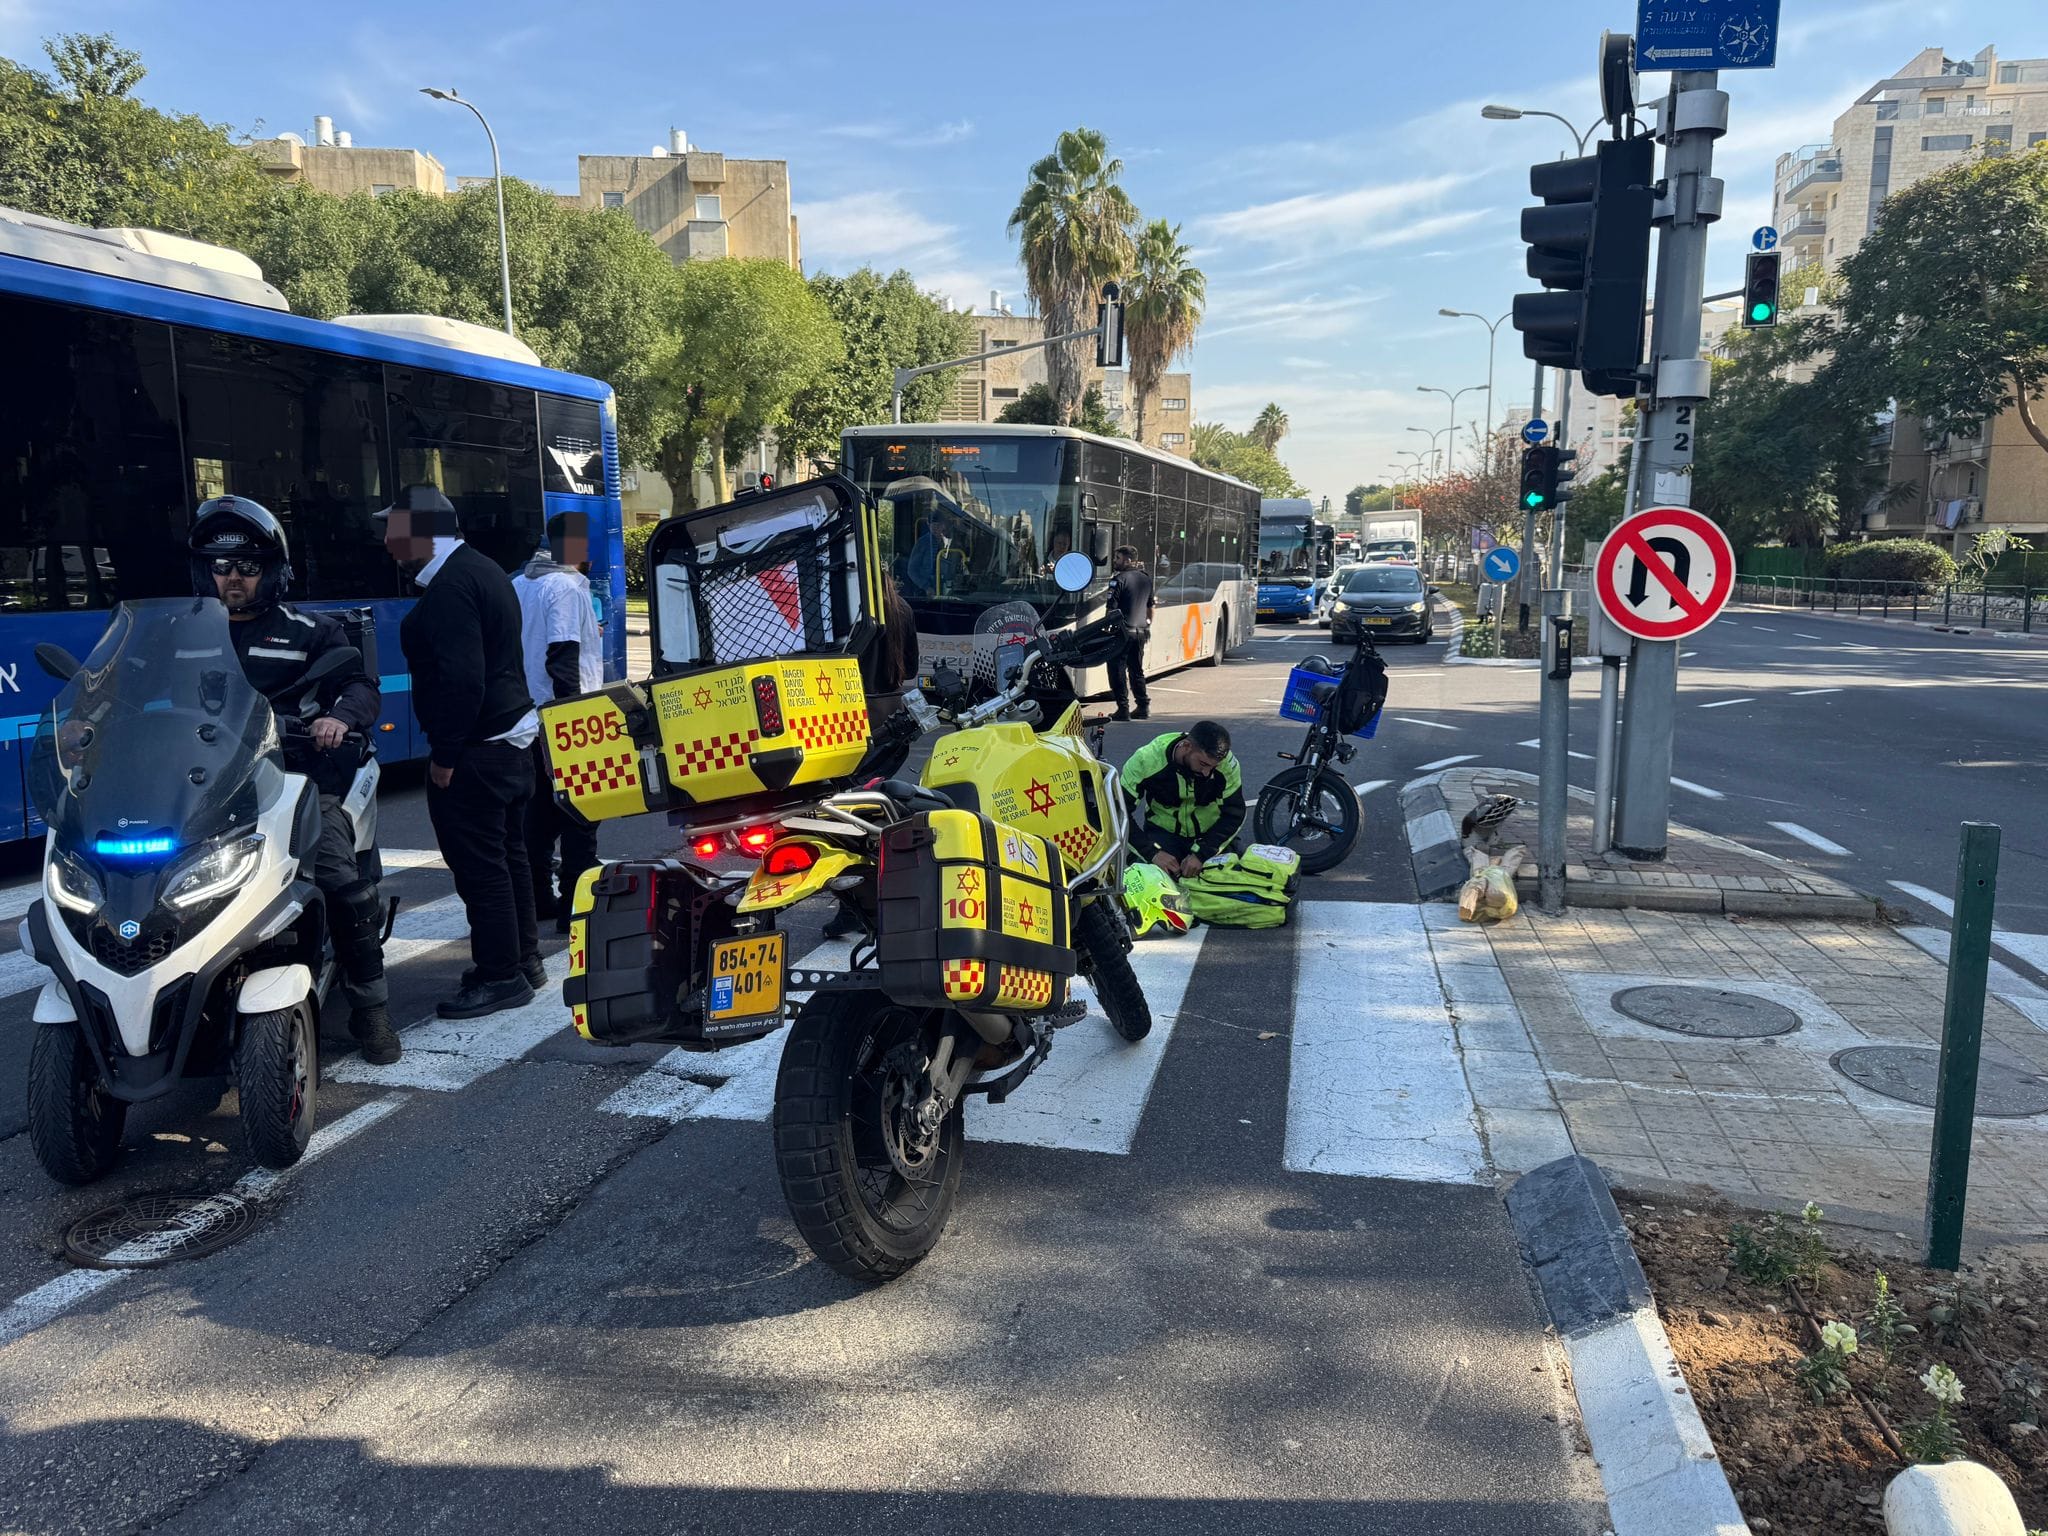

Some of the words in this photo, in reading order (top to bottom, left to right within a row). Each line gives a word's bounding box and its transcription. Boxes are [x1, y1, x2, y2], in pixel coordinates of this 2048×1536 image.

[1644, 11, 1653, 23] 5
[576, 483, 594, 495] DAN
[217, 534, 245, 544] SHOEI
[782, 669, 804, 678] MAGEN
[835, 668, 846, 678] דוד
[848, 668, 858, 679] מגן
[715, 679, 727, 688] דוד
[731, 676, 744, 687] מגן
[784, 679, 803, 688] DAVID
[845, 680, 862, 690] אדום
[660, 689, 683, 700] MAGEN
[726, 685, 746, 697] אדום
[787, 688, 805, 697] ADOM
[661, 697, 681, 707] DAVID
[716, 695, 747, 708] בישראל
[788, 699, 794, 707] IN
[796, 697, 816, 707] ISRAEL
[838, 692, 863, 703] בישראל
[663, 703, 683, 713] ADOM
[672, 708, 693, 718] ISRAEL
[555, 711, 621, 751] 5595
[1050, 773, 1060, 783] דוד
[1063, 770, 1074, 780] מגן
[1061, 781, 1078, 792] אדום
[991, 787, 1014, 800] MAGEN
[1055, 791, 1081, 805] בישראל
[995, 796, 1014, 807] DAVID
[999, 803, 1018, 815] ADOM
[1001, 815, 1009, 823] IN
[1010, 809, 1030, 820] ISRAEL
[944, 898, 985, 921] 101
[720, 942, 777, 972] 854-74
[734, 970, 762, 994] 401
[718, 991, 727, 1000] IL
